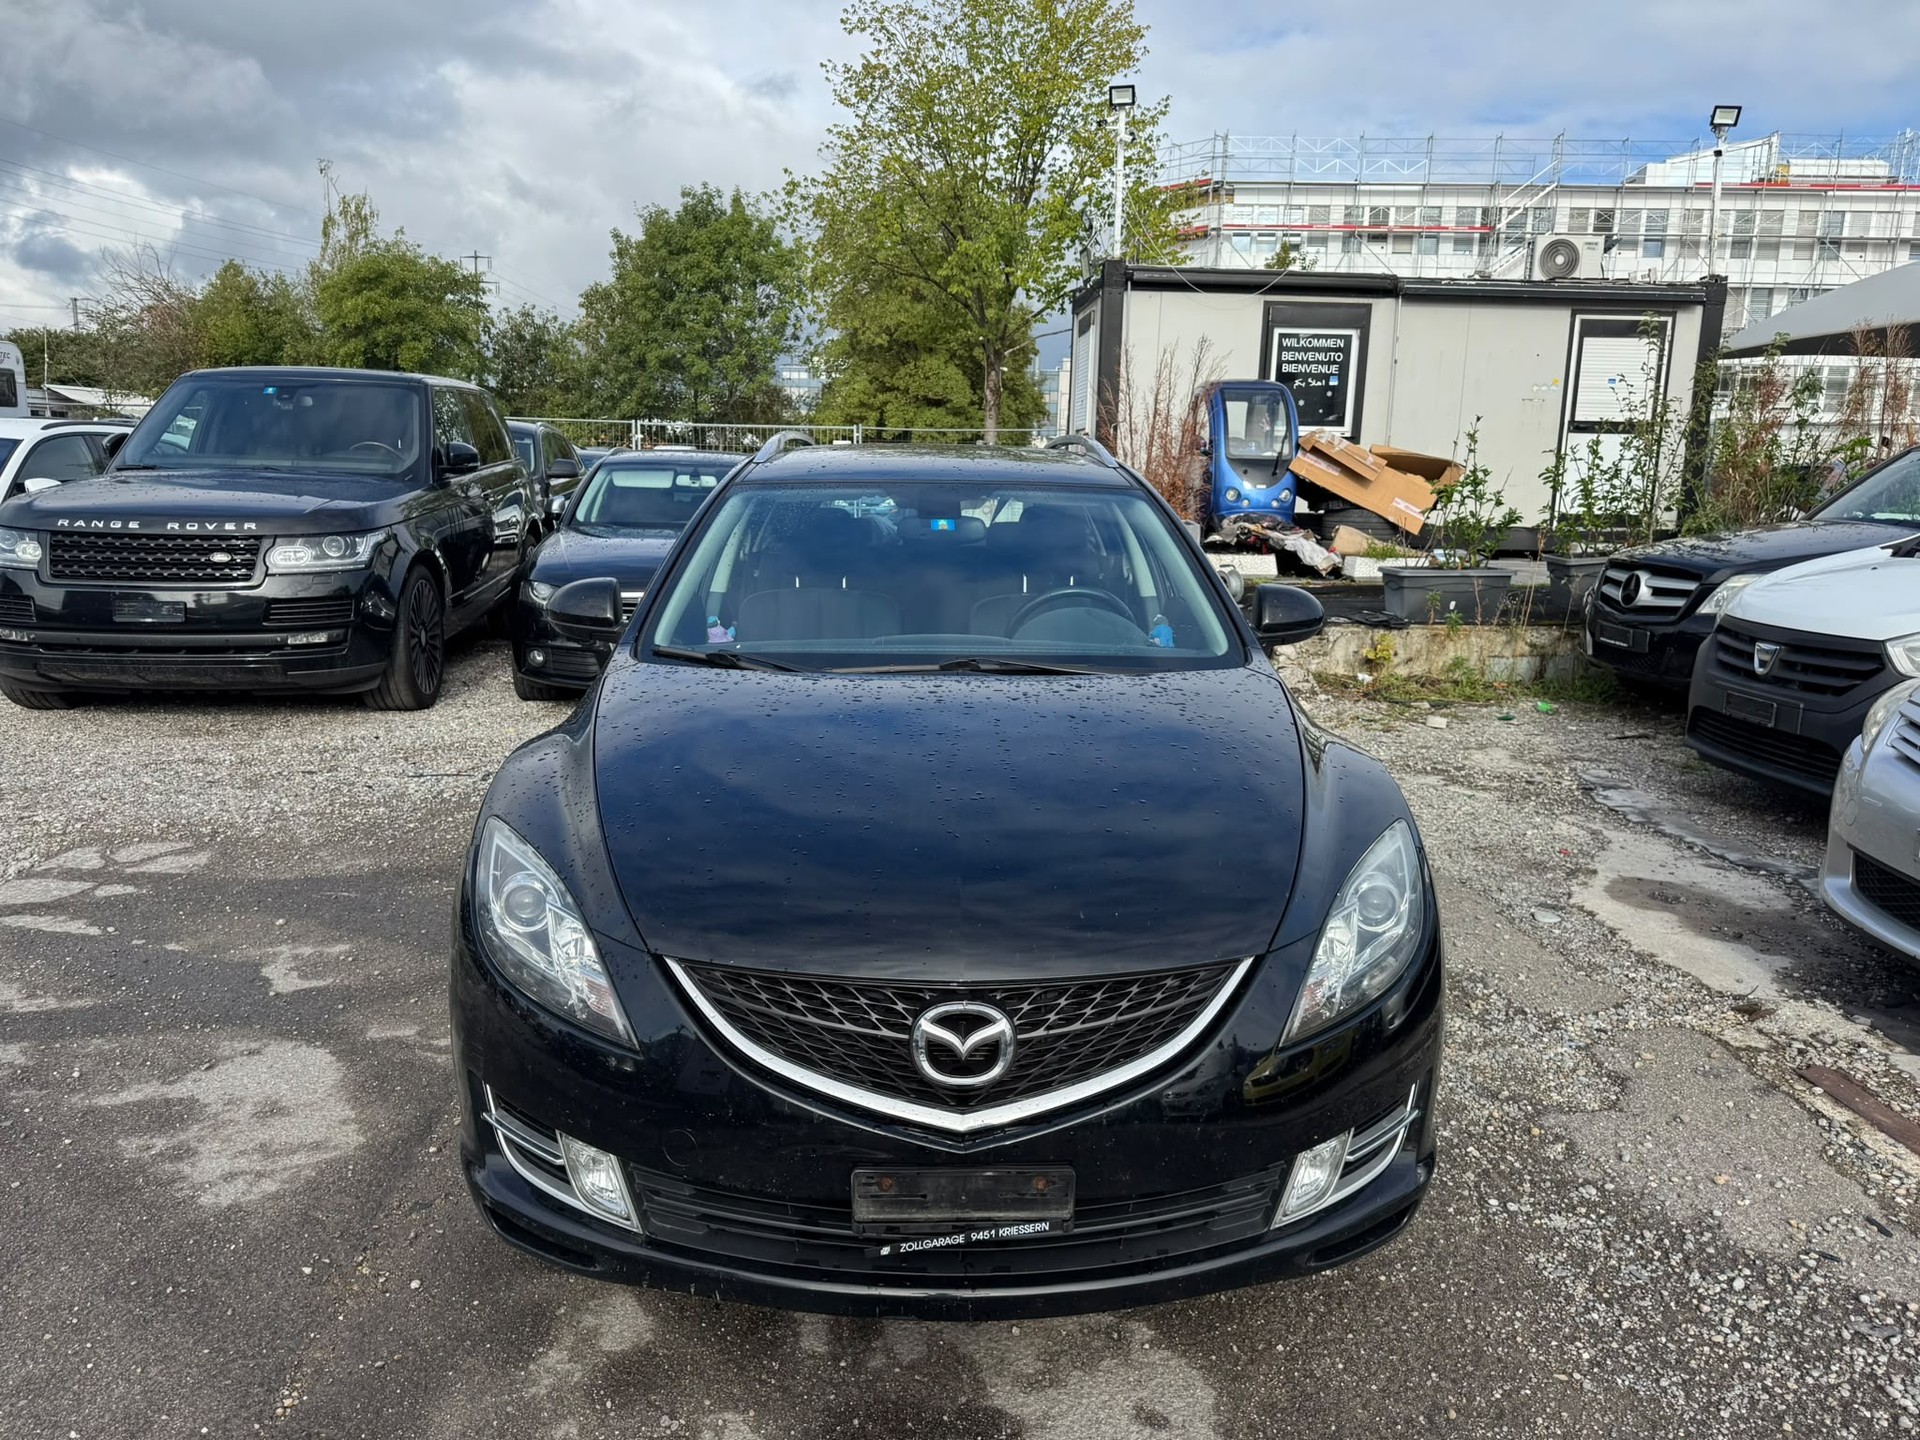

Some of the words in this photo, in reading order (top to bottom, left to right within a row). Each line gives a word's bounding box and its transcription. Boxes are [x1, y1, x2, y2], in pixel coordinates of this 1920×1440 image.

[1281, 337, 1345, 348] WILKOMMEN
[1281, 351, 1344, 362] BENVENUTO
[1281, 363, 1340, 374] BIENVENUE
[57, 519, 141, 529] RANGE
[166, 522, 257, 530] ROVER
[899, 1234, 966, 1253] ZOLLGARAGE
[970, 1229, 996, 1242] 9451
[998, 1221, 1050, 1238] KRIESSERN
